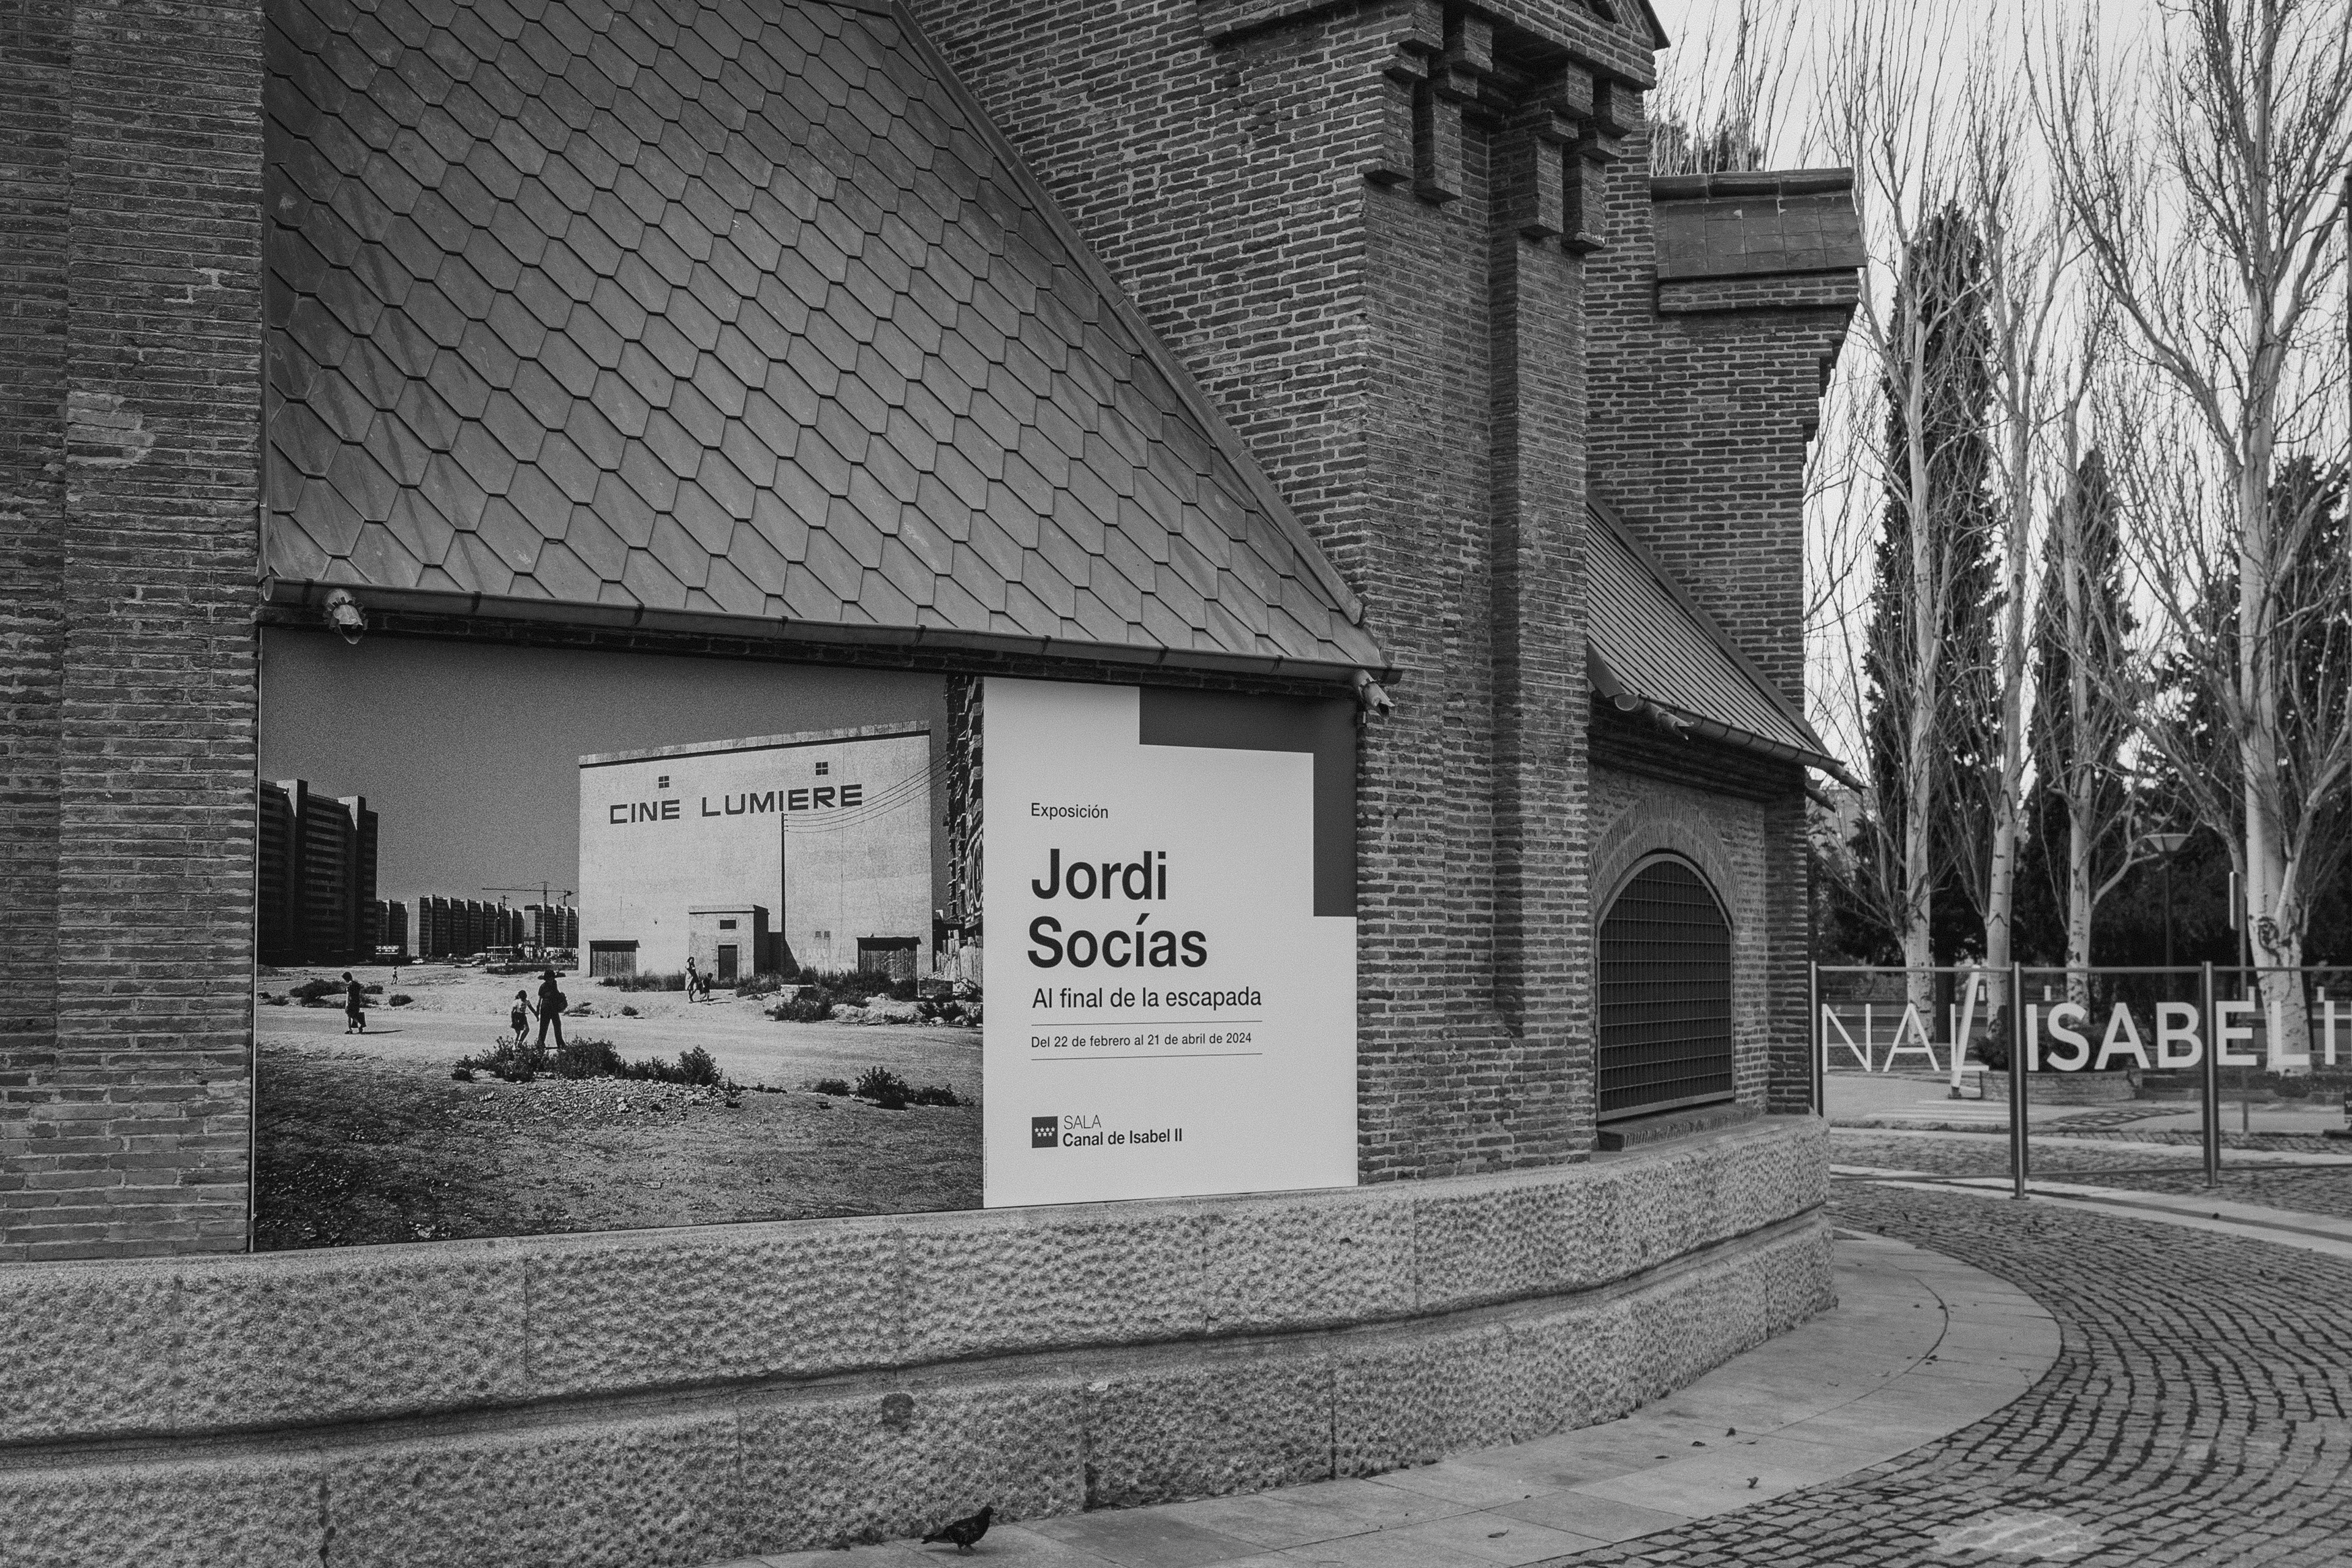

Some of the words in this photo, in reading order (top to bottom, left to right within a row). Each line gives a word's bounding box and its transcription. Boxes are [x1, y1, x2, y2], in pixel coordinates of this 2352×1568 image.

[610, 799, 680, 824] CINE
[702, 783, 863, 817] LUMIERE
[1031, 802, 1109, 820] Exposición
[1031, 848, 1166, 900] Jordi
[1027, 913, 1207, 968] Socías
[1032, 987, 1053, 1009] Al
[1059, 987, 1103, 1008] final
[1110, 987, 1136, 1008] de
[1142, 987, 1160, 1008] la
[1166, 986, 1262, 1011] escapada
[1031, 1036, 1050, 1048] Del
[1054, 1036, 1068, 1047] 22
[1071, 1036, 1087, 1047] de
[1090, 1035, 1131, 1047] febrero
[1134, 1034, 1144, 1046] al
[1147, 1034, 1159, 1046] 21
[1164, 1034, 1178, 1045] de
[1182, 1033, 1205, 1045] abril
[1208, 1033, 1223, 1044] de
[1226, 1032, 1252, 1044] 2024
[1063, 1114, 1102, 1130] SALA
[1063, 1131, 1103, 1147] Canal
[1107, 1131, 1125, 1145] de
[1129, 1128, 1170, 1144] Isabel
[1175, 1128, 1183, 1142] II
